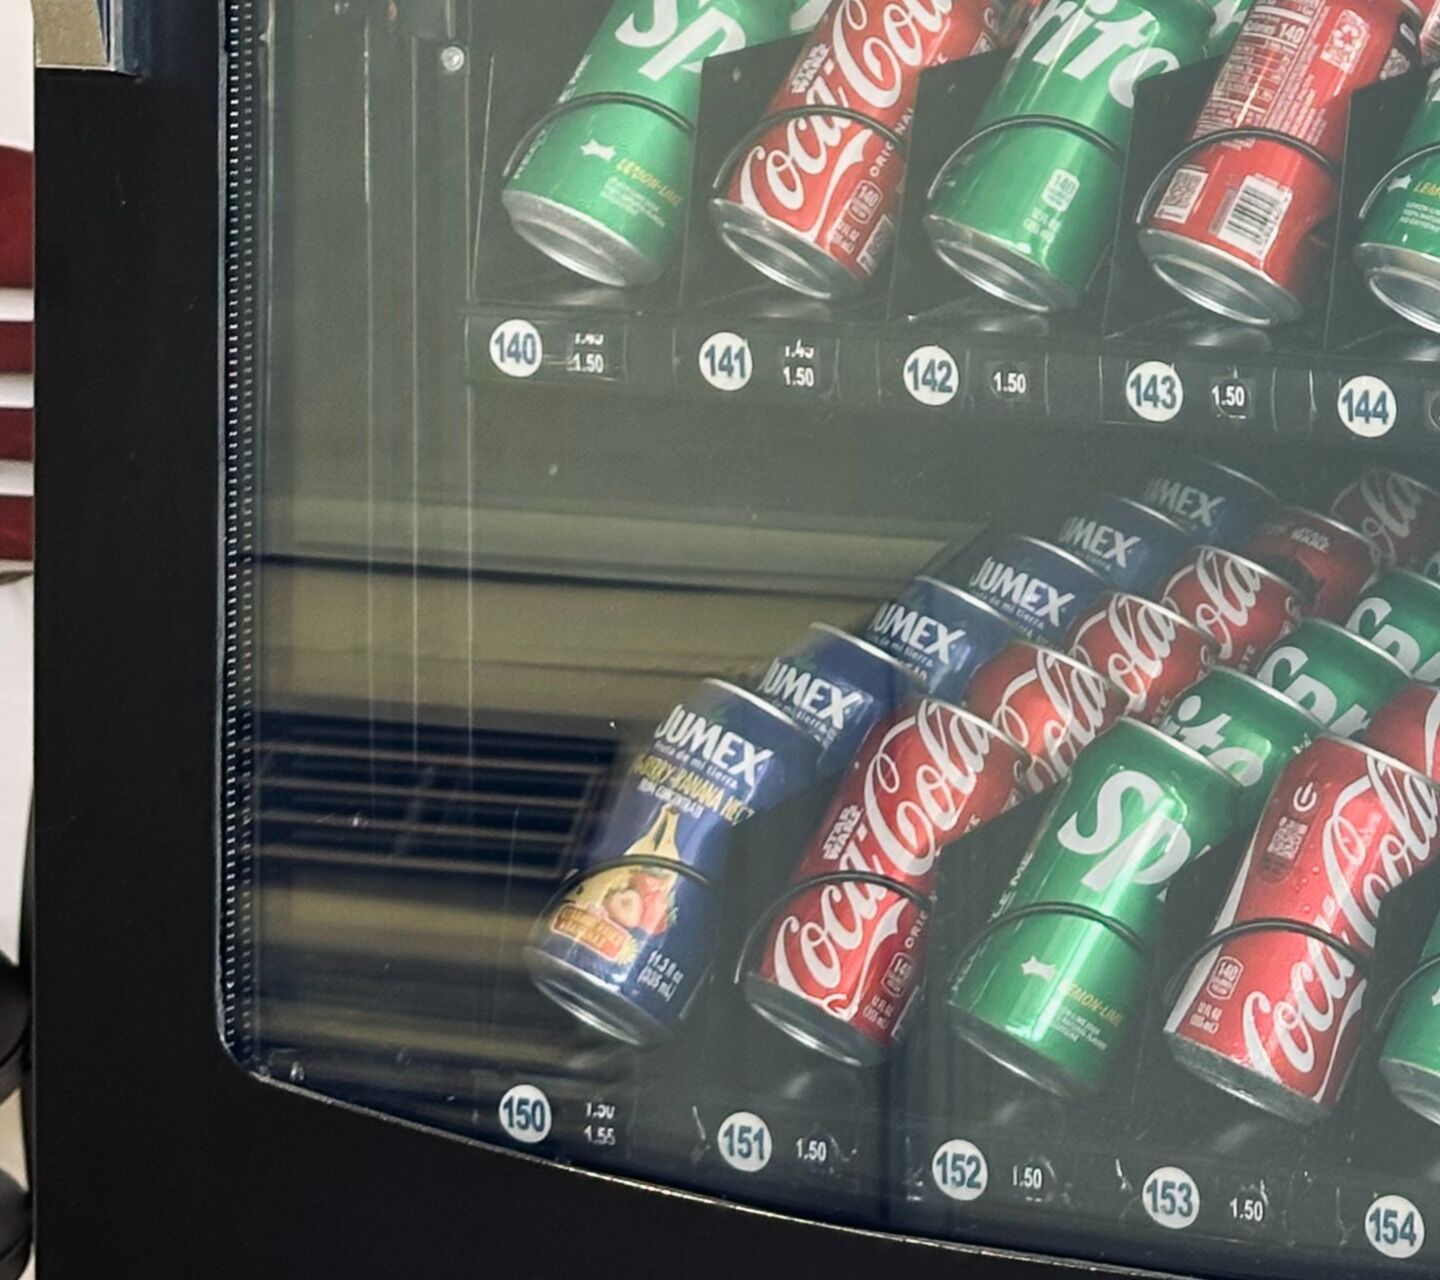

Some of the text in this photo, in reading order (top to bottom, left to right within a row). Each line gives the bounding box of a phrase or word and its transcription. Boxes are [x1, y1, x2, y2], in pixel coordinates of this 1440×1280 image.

[494, 330, 535, 365] 140
[572, 354, 604, 374] 1.50
[703, 343, 748, 379] 141
[783, 367, 815, 388] 1.50
[906, 358, 953, 394] 142
[992, 372, 1027, 394] 1.50
[1129, 373, 1178, 411] 143
[1211, 385, 1245, 407] 1.50
[1341, 389, 1391, 426] 144
[653, 704, 774, 787] JUMEX
[773, 697, 992, 995] Coca-Cola
[502, 1099, 545, 1131] 150
[723, 1127, 765, 1162] 151
[795, 1138, 827, 1163] 1.50
[936, 1154, 983, 1190] 152
[1012, 1165, 1043, 1190] 1.50
[1146, 1181, 1194, 1214] 153
[1229, 1199, 1264, 1223] 1.50
[1369, 1209, 1417, 1244] 154
